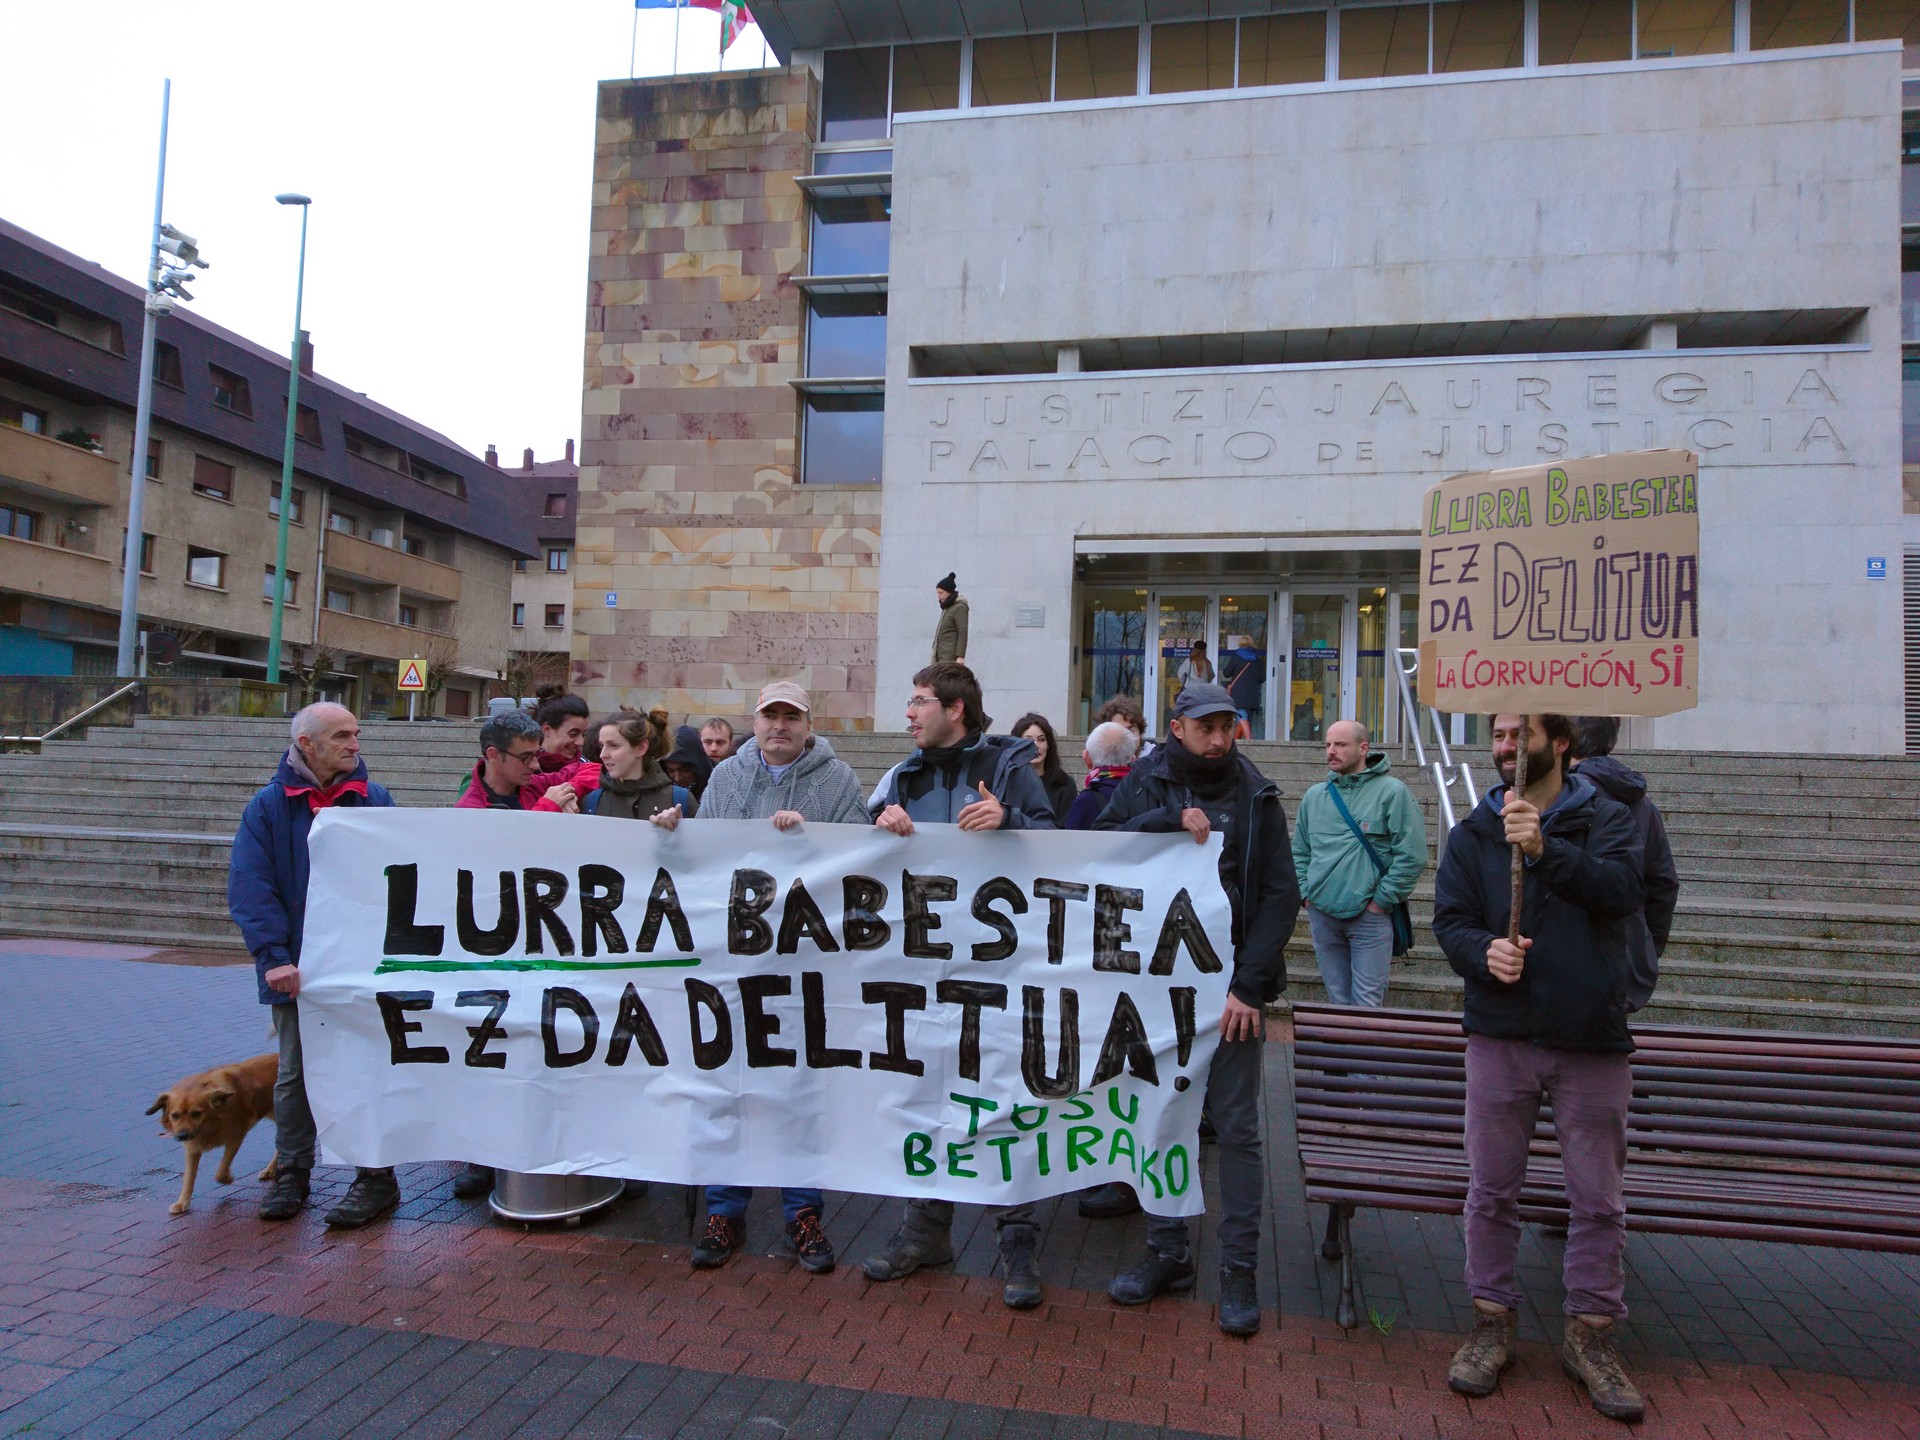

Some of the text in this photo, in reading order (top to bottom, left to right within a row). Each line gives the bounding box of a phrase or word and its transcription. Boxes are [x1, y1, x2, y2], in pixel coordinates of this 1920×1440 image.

[929, 369, 1839, 426] JUSTIZIA JAUREGIA
[929, 416, 1847, 472] PALACIO DE JUSTICIA
[1428, 468, 1698, 537] LURRA BABESTEA
[1428, 543, 1481, 586] EZ
[1430, 596, 1474, 633] DA
[1436, 659, 1456, 689] LA
[383, 863, 1223, 976] LURRA BABESTEA
[376, 971, 1198, 1100] EZ DA DELITUA!
[949, 1086, 1139, 1137] TOSU
[903, 1125, 1190, 1199] BETIRAKO
